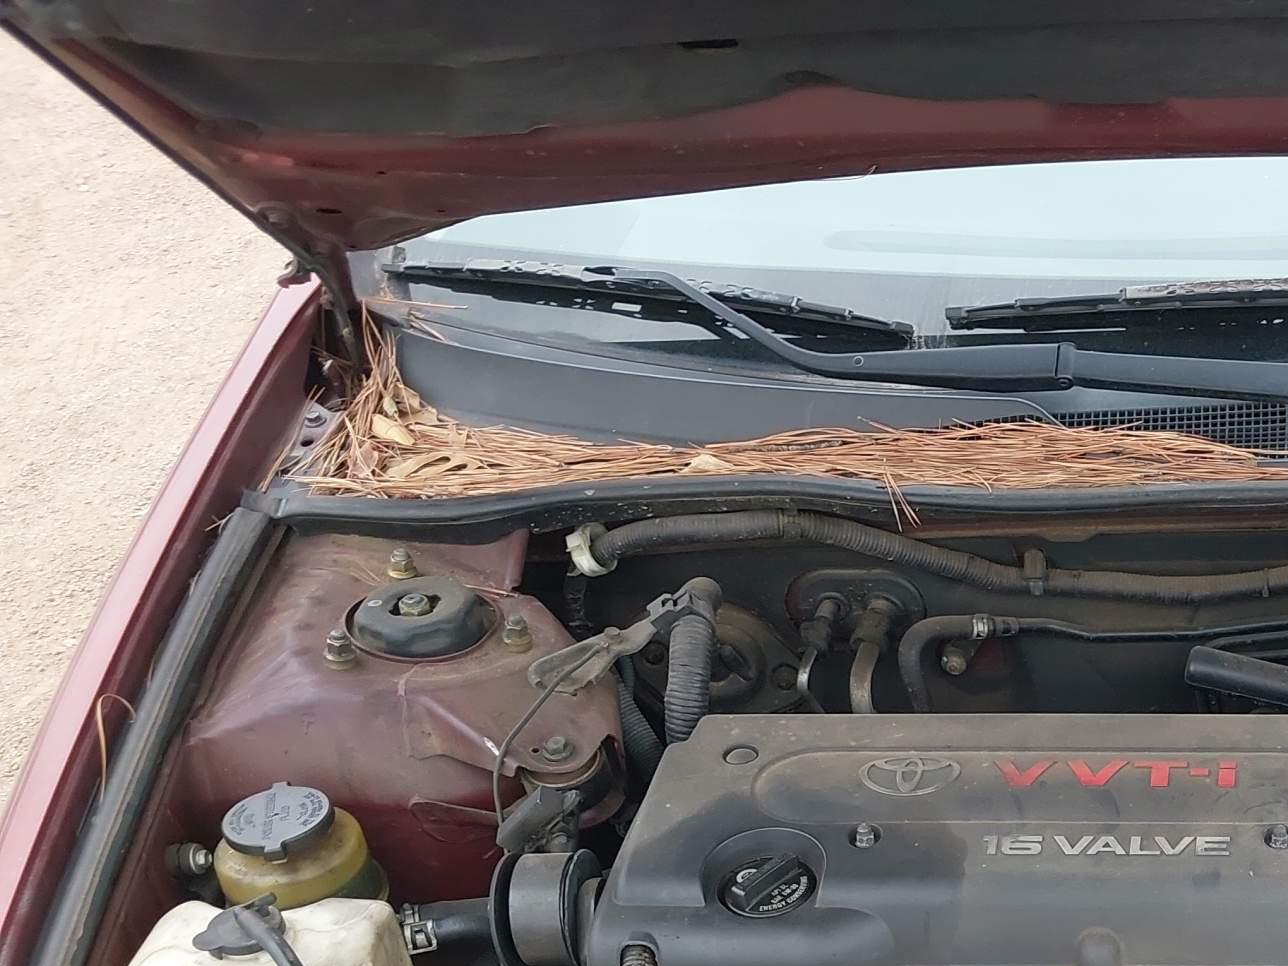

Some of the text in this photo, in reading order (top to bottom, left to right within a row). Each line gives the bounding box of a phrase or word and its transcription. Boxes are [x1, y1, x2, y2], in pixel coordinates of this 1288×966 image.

[993, 760, 1238, 789] VVT-i
[983, 835, 1232, 856] 16 VALVE
[759, 900, 786, 912] ENERGY
